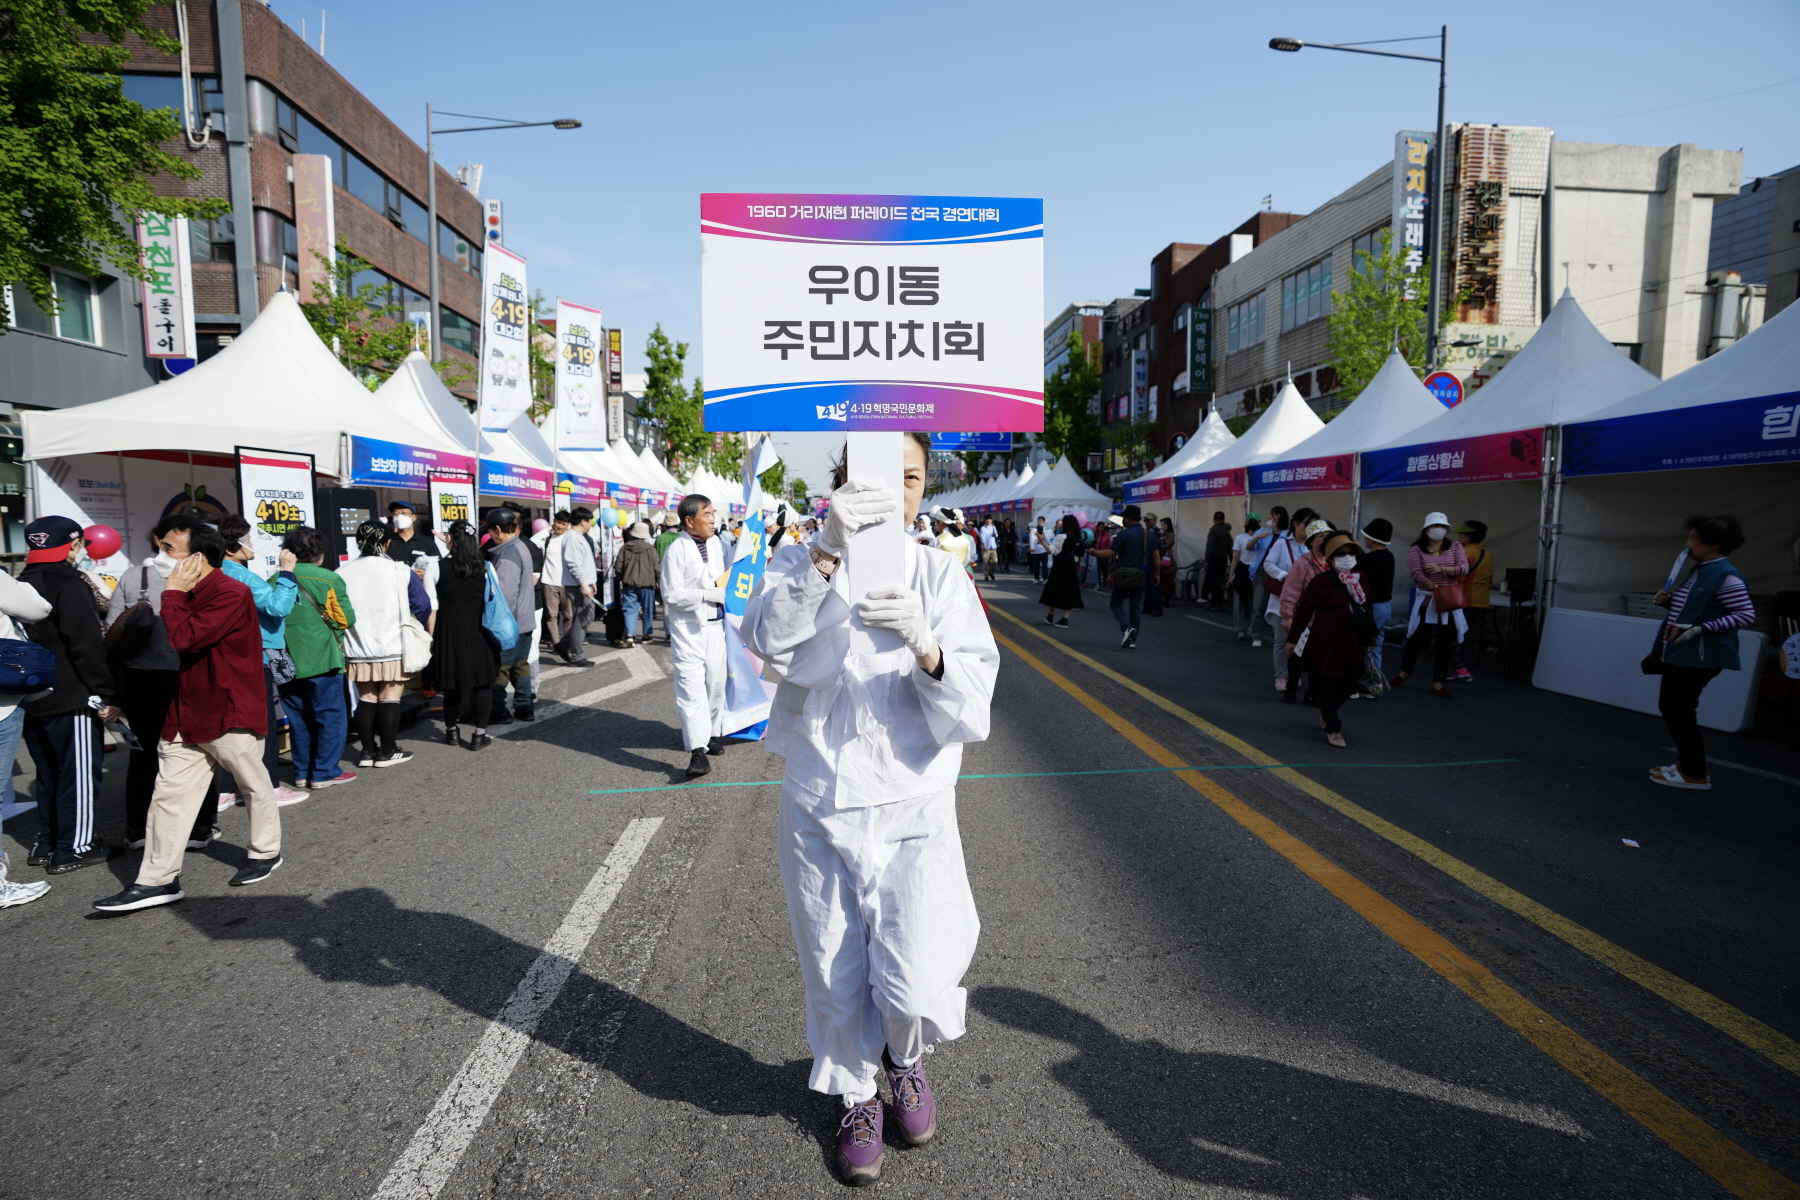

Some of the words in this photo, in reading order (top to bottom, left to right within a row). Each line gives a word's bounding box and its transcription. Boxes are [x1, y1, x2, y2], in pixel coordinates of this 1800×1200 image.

[747, 205, 787, 218] 1960
[789, 206, 848, 220] 거리재현
[850, 206, 908, 221] 퍼레이드
[911, 207, 940, 221] 전국
[942, 208, 1000, 223] 경연대회
[808, 265, 940, 306] 우이동
[491, 298, 526, 325] 4·19
[1193, 311, 1210, 319] The
[153, 298, 175, 352] 돌구이
[763, 319, 985, 362] 주민자치회
[563, 344, 595, 365] 4·19
[371, 457, 397, 474] 보보와
[397, 460, 413, 476] 함께
[1406, 450, 1465, 473] 합동상황실
[1295, 465, 1327, 481] 경찰본부
[441, 505, 469, 520] MBTI
